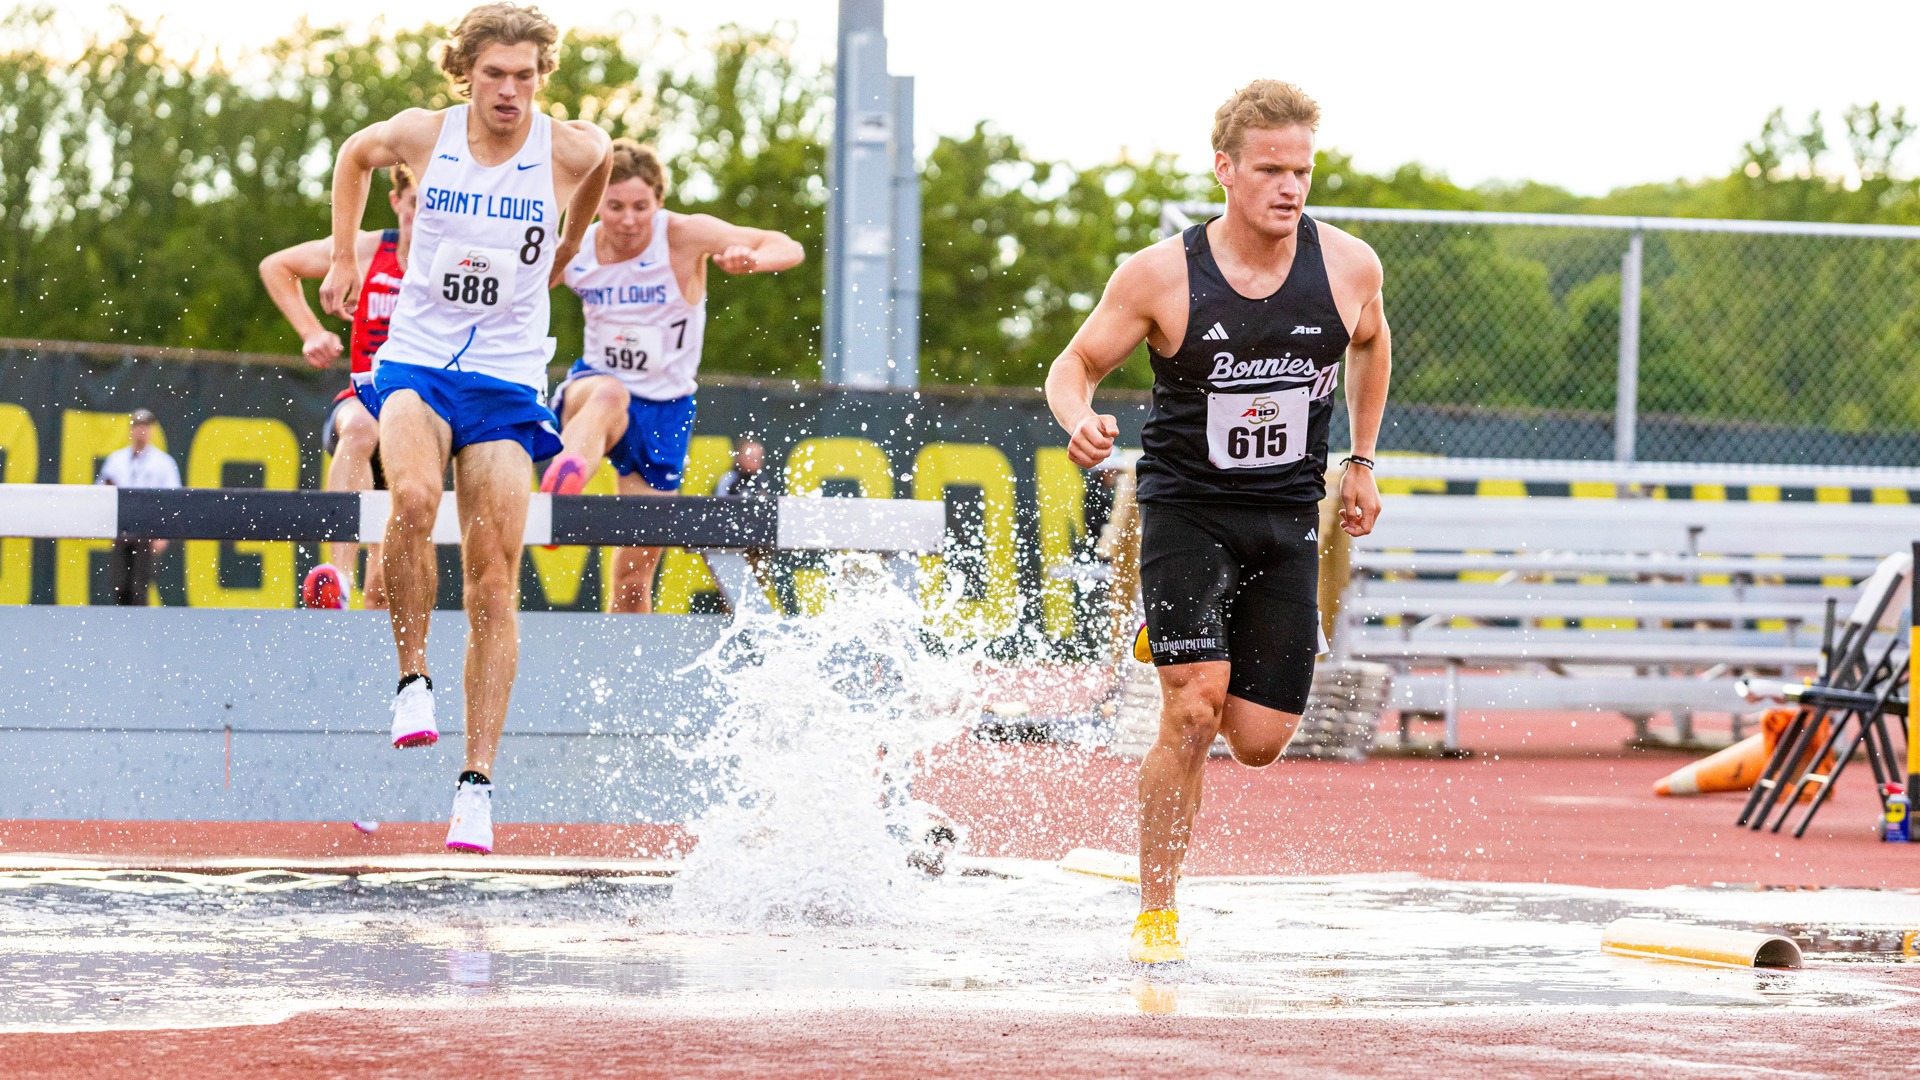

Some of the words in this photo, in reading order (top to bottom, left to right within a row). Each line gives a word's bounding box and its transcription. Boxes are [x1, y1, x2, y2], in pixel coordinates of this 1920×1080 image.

[426, 187, 483, 215] SAINT
[487, 195, 543, 222] LOUIS
[519, 226, 545, 265] 8
[442, 273, 499, 306] 588
[619, 285, 666, 304] LOUIS
[671, 318, 688, 350] 7
[1290, 325, 1322, 335] A10
[605, 346, 648, 371] 592
[1207, 351, 1317, 381] Bonnies
[1240, 408, 1276, 418] A10
[1227, 423, 1288, 460] 615
